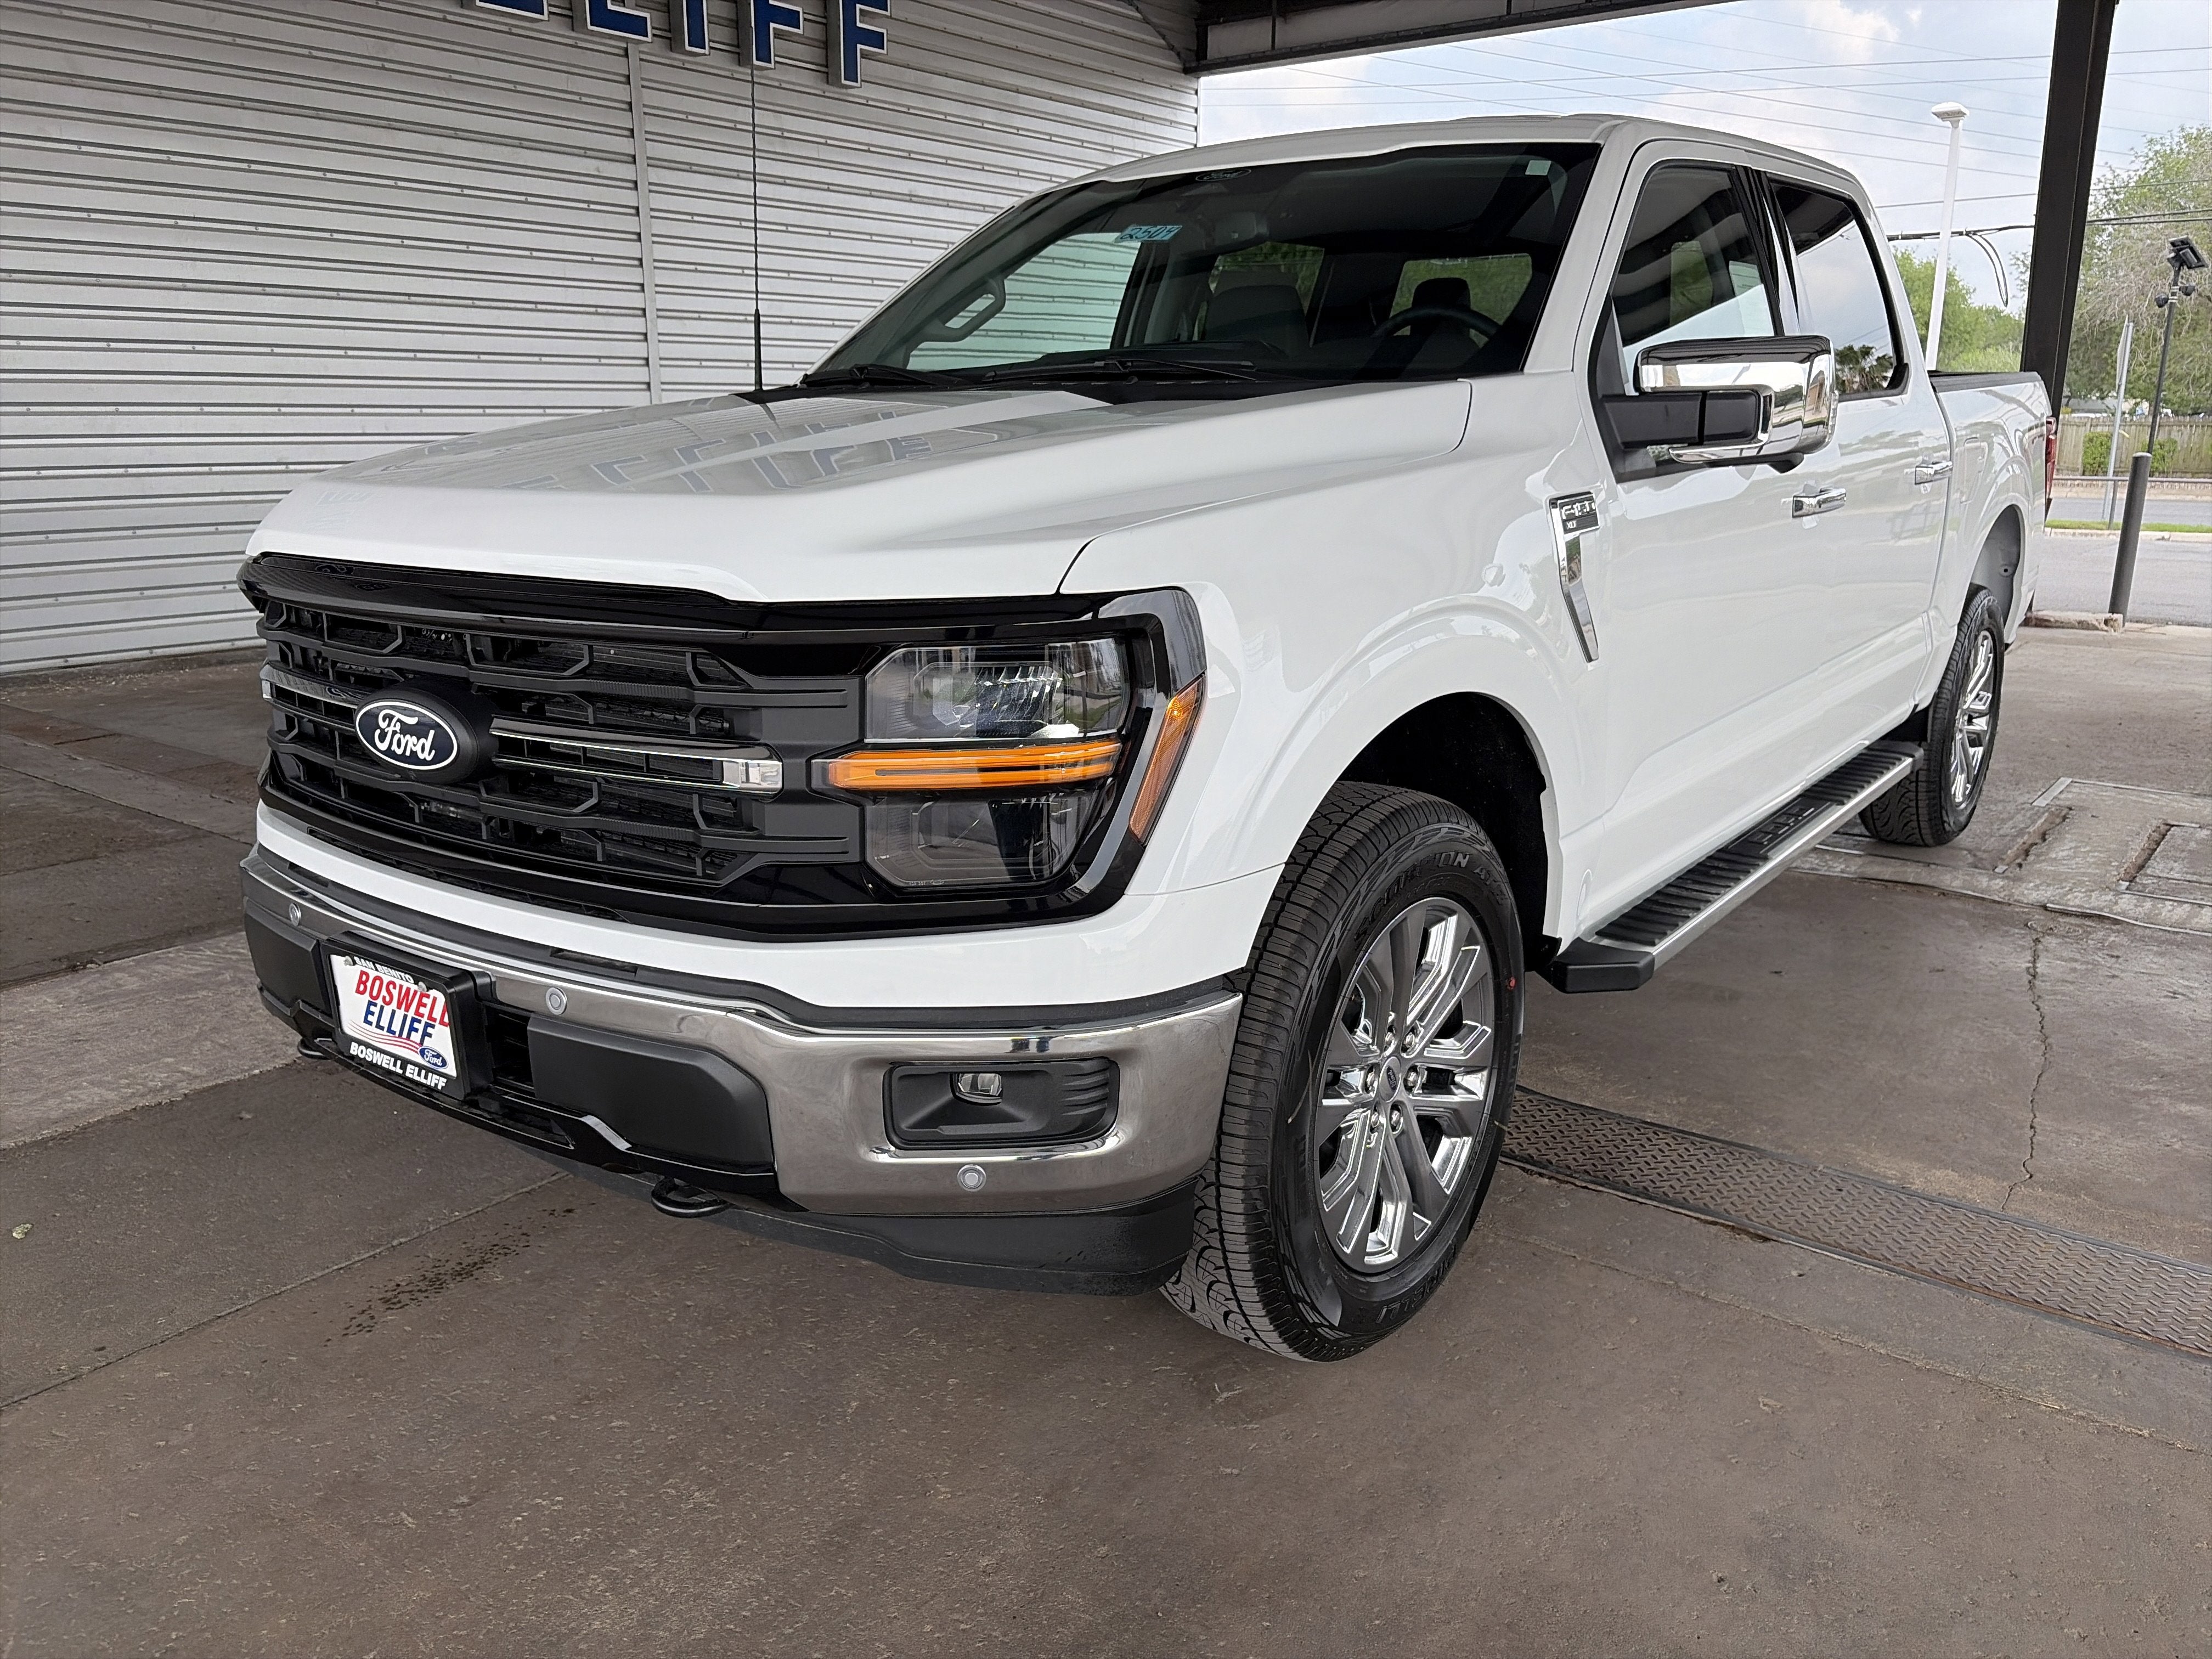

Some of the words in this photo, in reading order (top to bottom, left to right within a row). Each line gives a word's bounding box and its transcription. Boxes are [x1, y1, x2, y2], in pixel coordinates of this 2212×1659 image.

[1566, 521, 1577, 530] XLT
[375, 709, 436, 761] Ford
[353, 956, 376, 970] SAN
[375, 963, 414, 984] BENITO
[355, 969, 450, 1028] BOSWELL
[363, 1000, 436, 1046] ELLIFF
[350, 1042, 403, 1075] BOSWELL
[405, 1064, 447, 1091] ELLIFF
[424, 1049, 443, 1067] Ford
